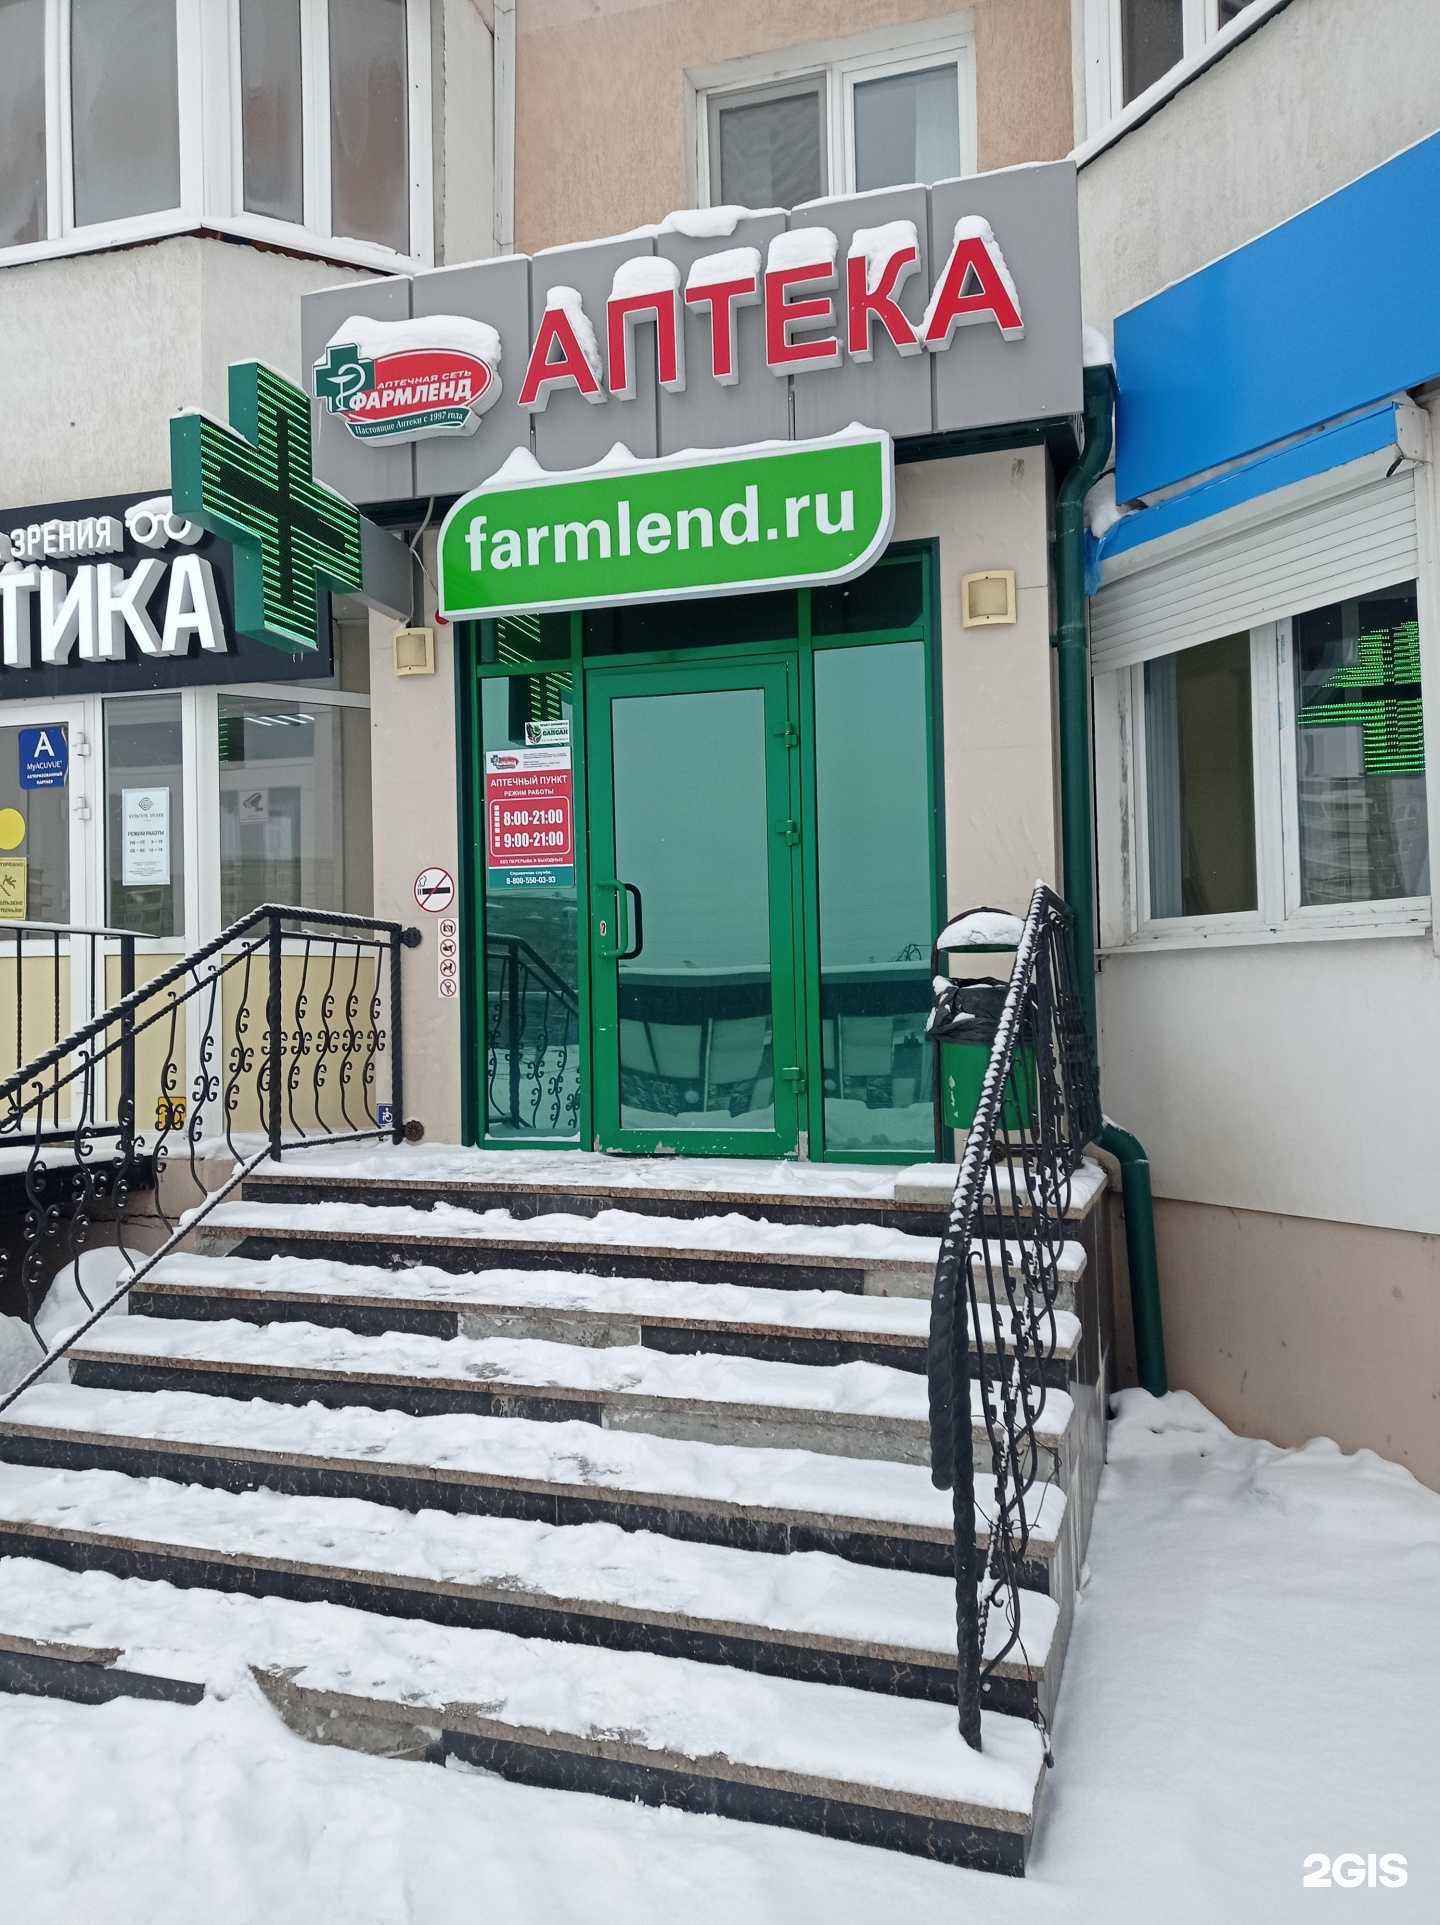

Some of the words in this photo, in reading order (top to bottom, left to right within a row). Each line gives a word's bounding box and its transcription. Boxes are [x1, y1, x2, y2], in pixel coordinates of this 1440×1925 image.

[518, 236, 1025, 408] АПТЕКА
[377, 374, 438, 389] АПТЕЧНАЯ
[442, 370, 472, 381] СЕТЬ
[349, 378, 472, 411] ФАРМЛЕНД
[396, 418, 422, 429] Аптеки
[430, 411, 447, 421] 1997
[10, 516, 113, 557] ЗРЕНИЯ
[464, 485, 855, 572] farmlend.ru
[490, 775, 538, 787] АПТЕЧНЫЙ
[540, 774, 568, 784] ПУНКТ
[528, 788, 554, 796] РАБОТЫ
[503, 808, 564, 826] 8:00-21:00
[503, 830, 564, 848] 9:00-21:00
